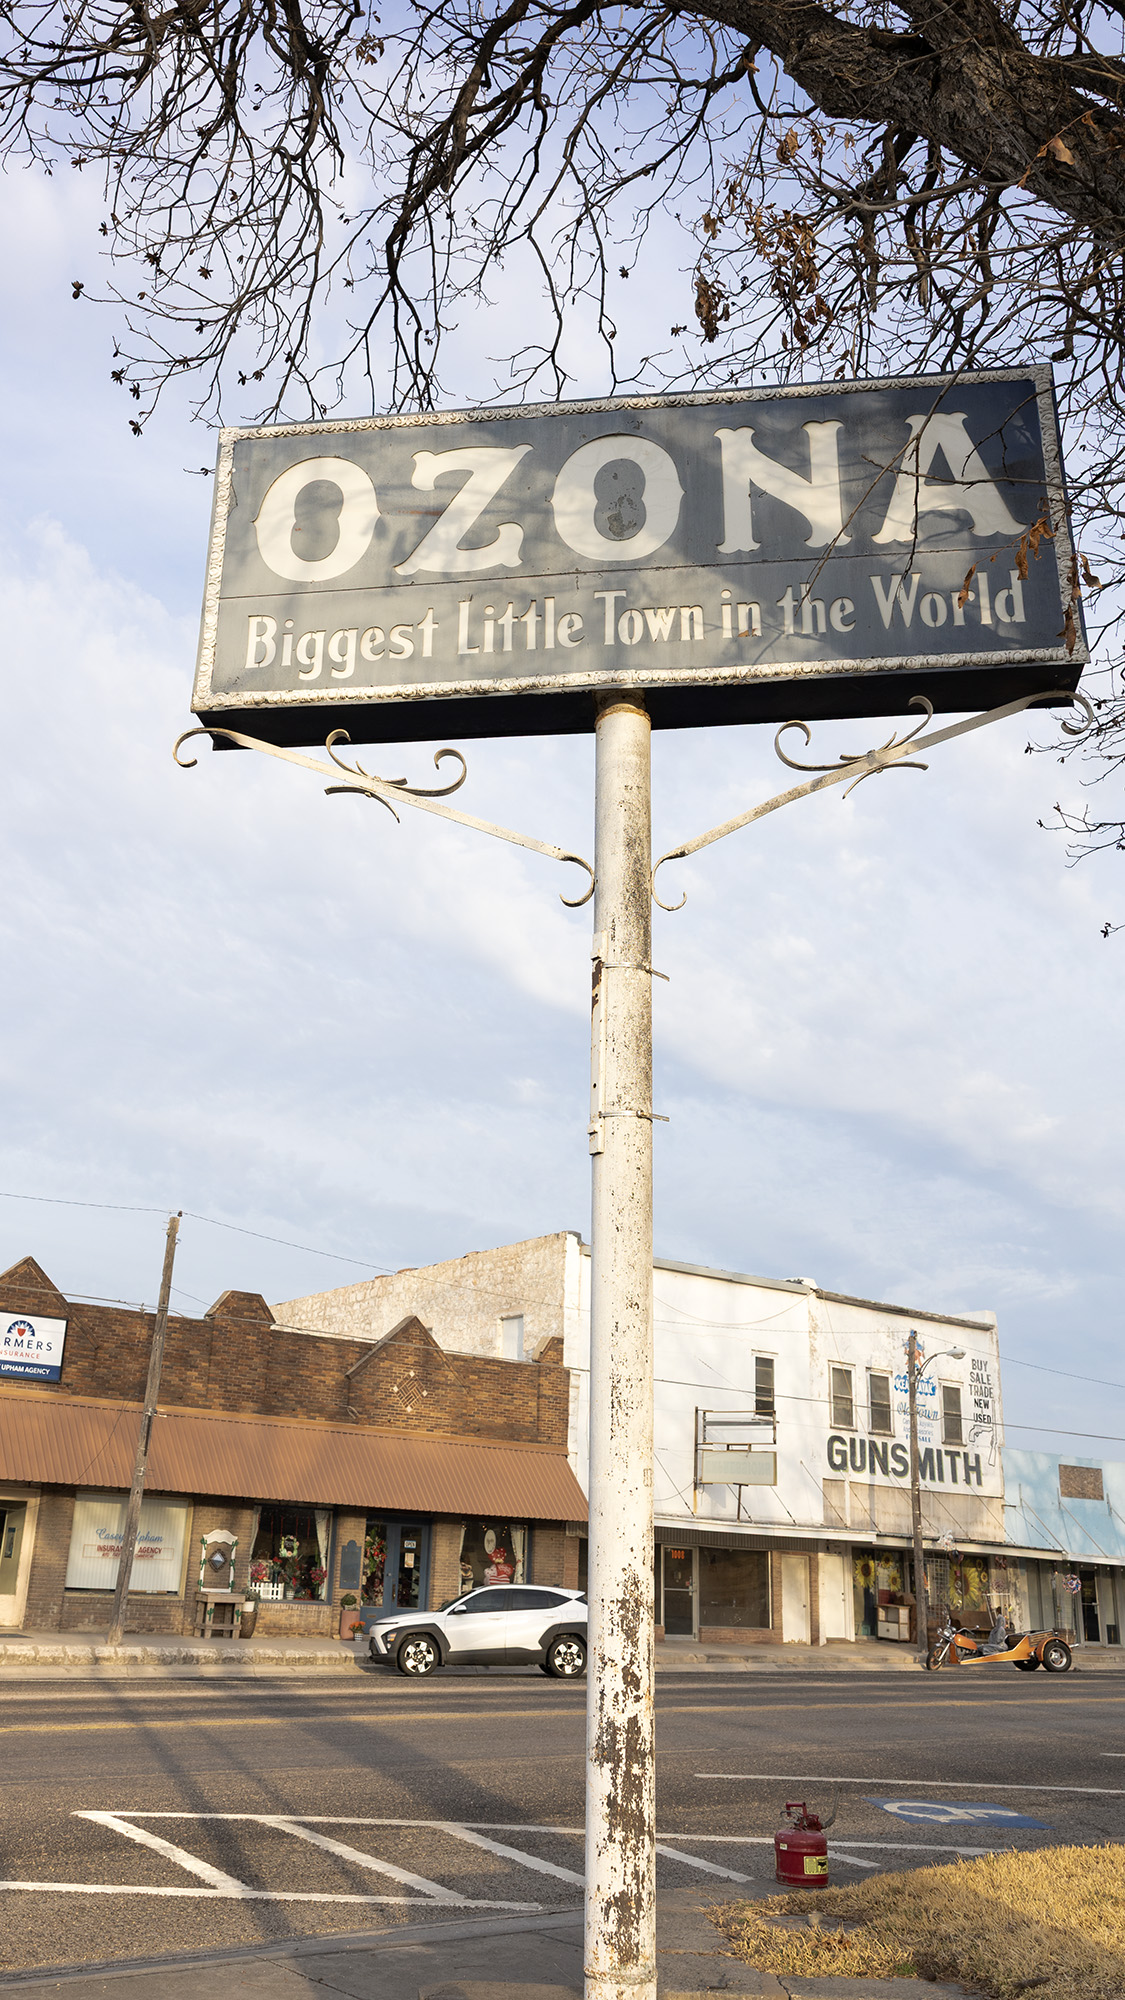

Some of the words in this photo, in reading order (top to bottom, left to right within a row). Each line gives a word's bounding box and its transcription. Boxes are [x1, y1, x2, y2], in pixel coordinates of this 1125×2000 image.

[254, 412, 1031, 583] OZONA
[245, 608, 439, 681] Biggest
[457, 596, 586, 655] Little
[594, 590, 704, 643] Town
[721, 589, 762, 639] in
[777, 582, 856, 635] the
[869, 570, 1026, 630] World
[3, 1337, 53, 1351] RMERS
[0, 1350, 40, 1359] NSURANCE
[1, 1364, 24, 1372] UPHAM
[25, 1367, 50, 1375] AGENCY
[971, 1358, 988, 1372] BUY
[970, 1371, 991, 1385] SALE
[969, 1383, 994, 1399] TRADE
[974, 1398, 990, 1409] NEW
[973, 1413, 992, 1424] USED
[827, 1435, 983, 1487] GUNSMITH
[96, 1528, 124, 1543] Casey
[97, 1545, 122, 1553] INSURA
[138, 1546, 163, 1554] AGENCY
